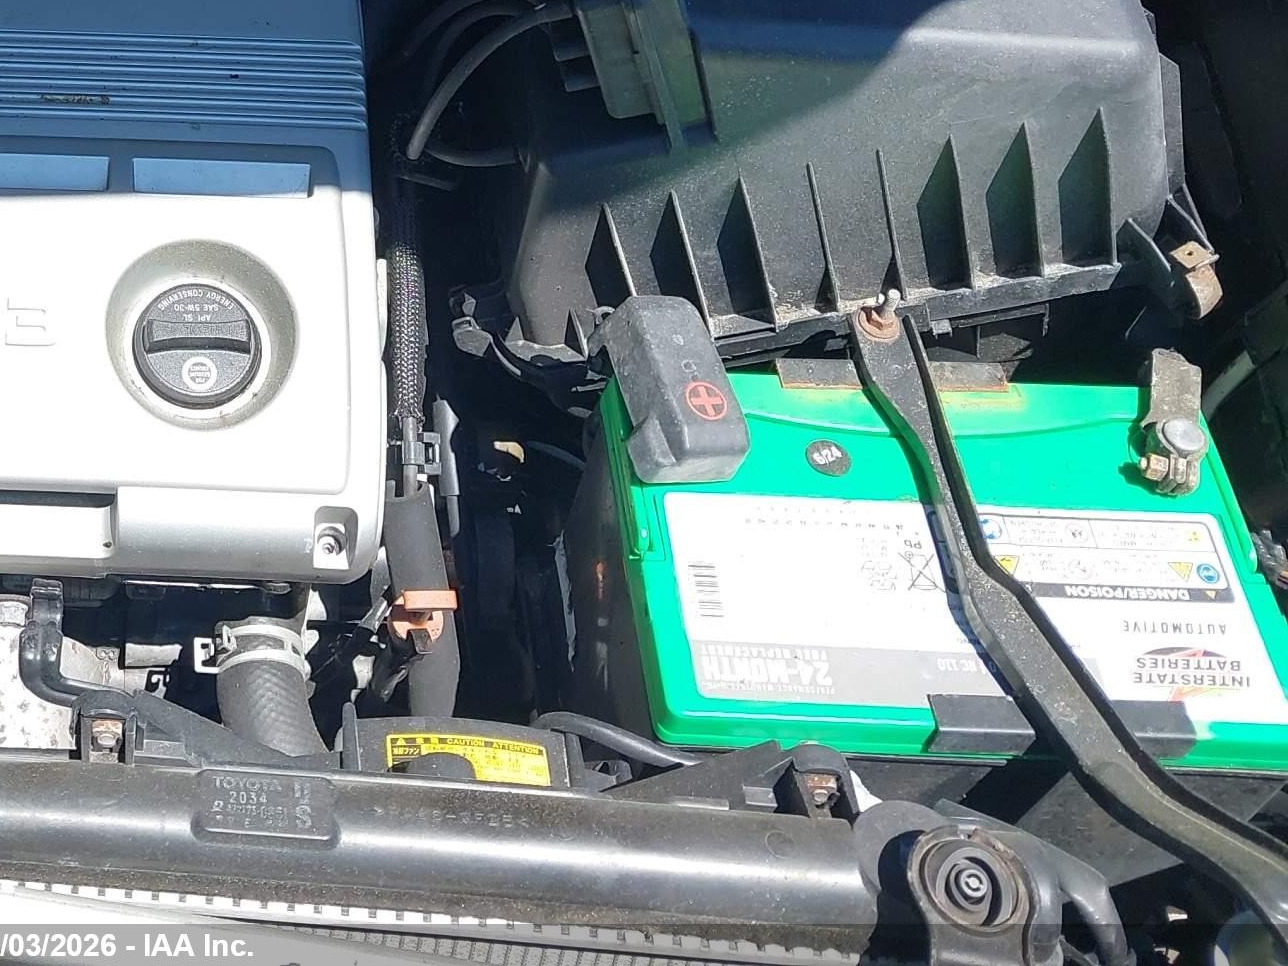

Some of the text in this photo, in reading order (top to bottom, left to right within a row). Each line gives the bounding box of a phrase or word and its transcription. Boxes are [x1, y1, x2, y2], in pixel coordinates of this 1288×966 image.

[157, 289, 235, 311] ENERGY CONSERVING
[174, 303, 219, 311] SAE 5W-30
[812, 446, 843, 466] 6/24
[903, 538, 922, 551] Pb
[1065, 585, 1191, 601] DANGER/POISON
[1122, 620, 1227, 636] AUTOMOTIVE
[701, 654, 833, 684] 24-MONTH
[937, 658, 959, 671] 110
[1135, 657, 1241, 672] BATTERIES
[1132, 671, 1251, 688] INTERSTATE
[447, 738, 485, 747] CAUTION
[492, 741, 540, 755] ATTENTION
[213, 775, 282, 792] TOYOTA
[229, 791, 268, 804] 2034
